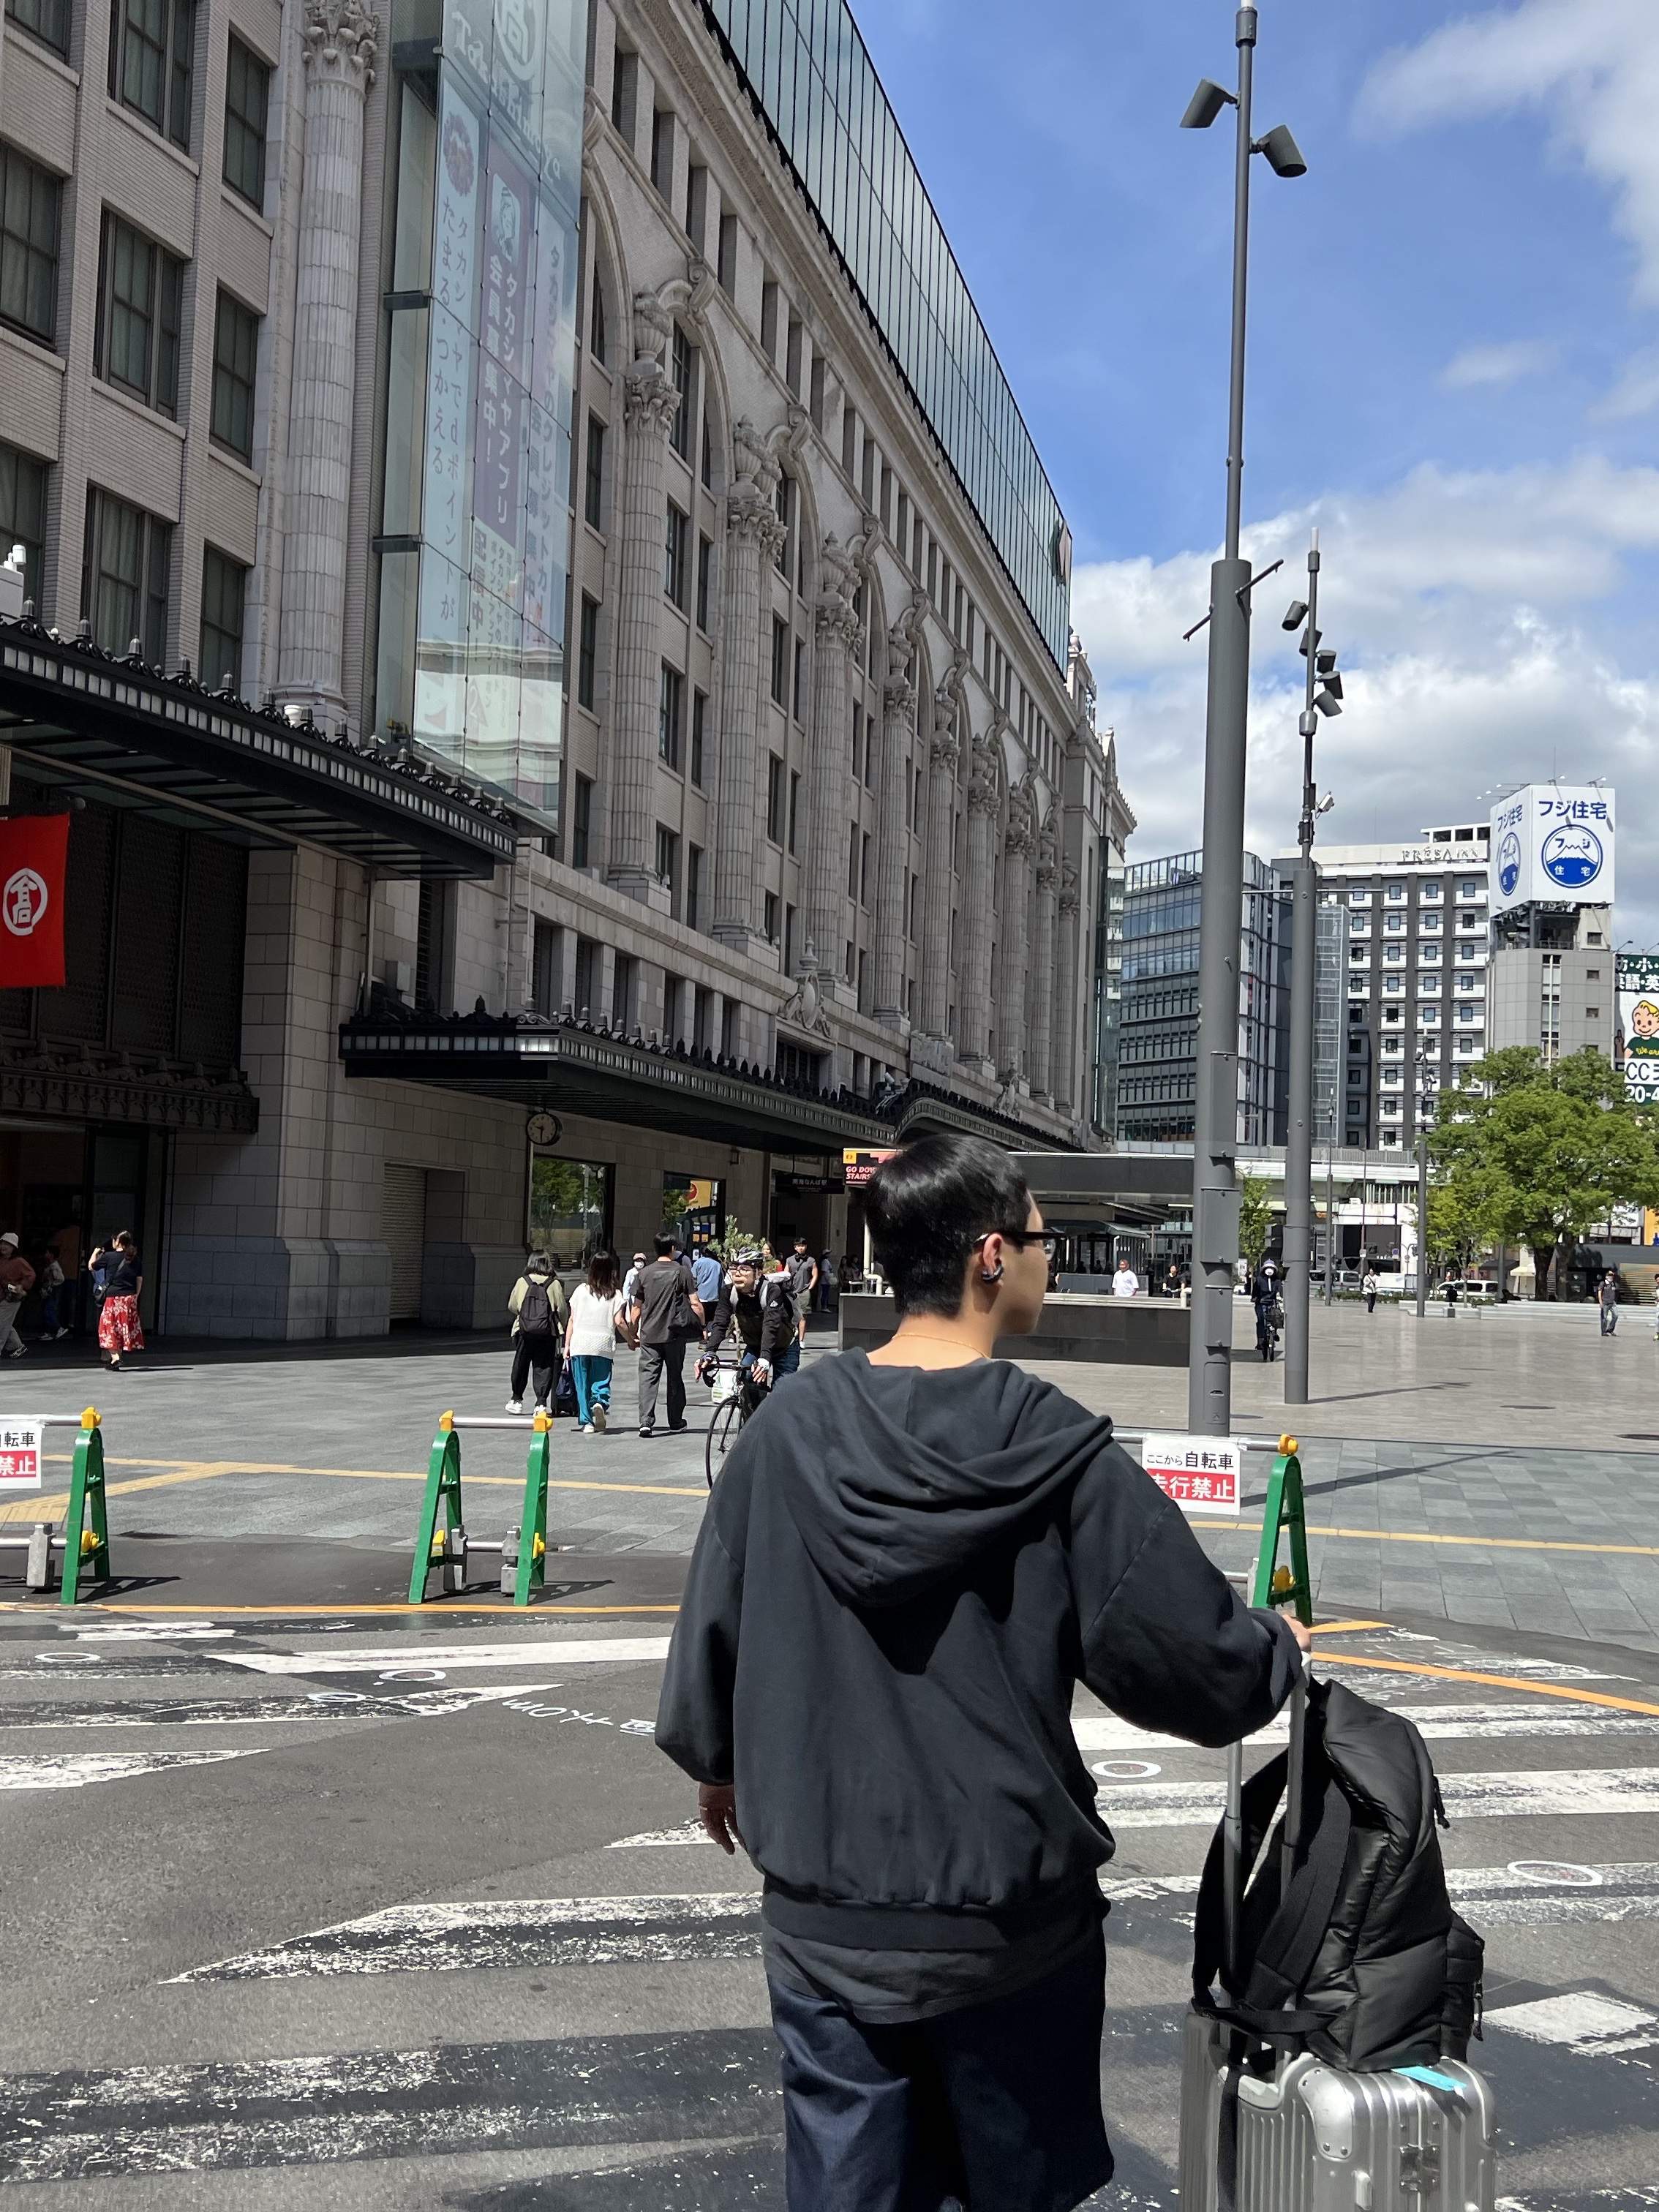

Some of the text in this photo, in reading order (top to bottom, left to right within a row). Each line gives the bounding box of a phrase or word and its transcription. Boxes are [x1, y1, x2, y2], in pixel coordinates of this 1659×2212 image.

[1538, 800, 1606, 819] フジ住宅
[0, 1431, 36, 1448] 転車
[1146, 1451, 1234, 1470] ここから自転車
